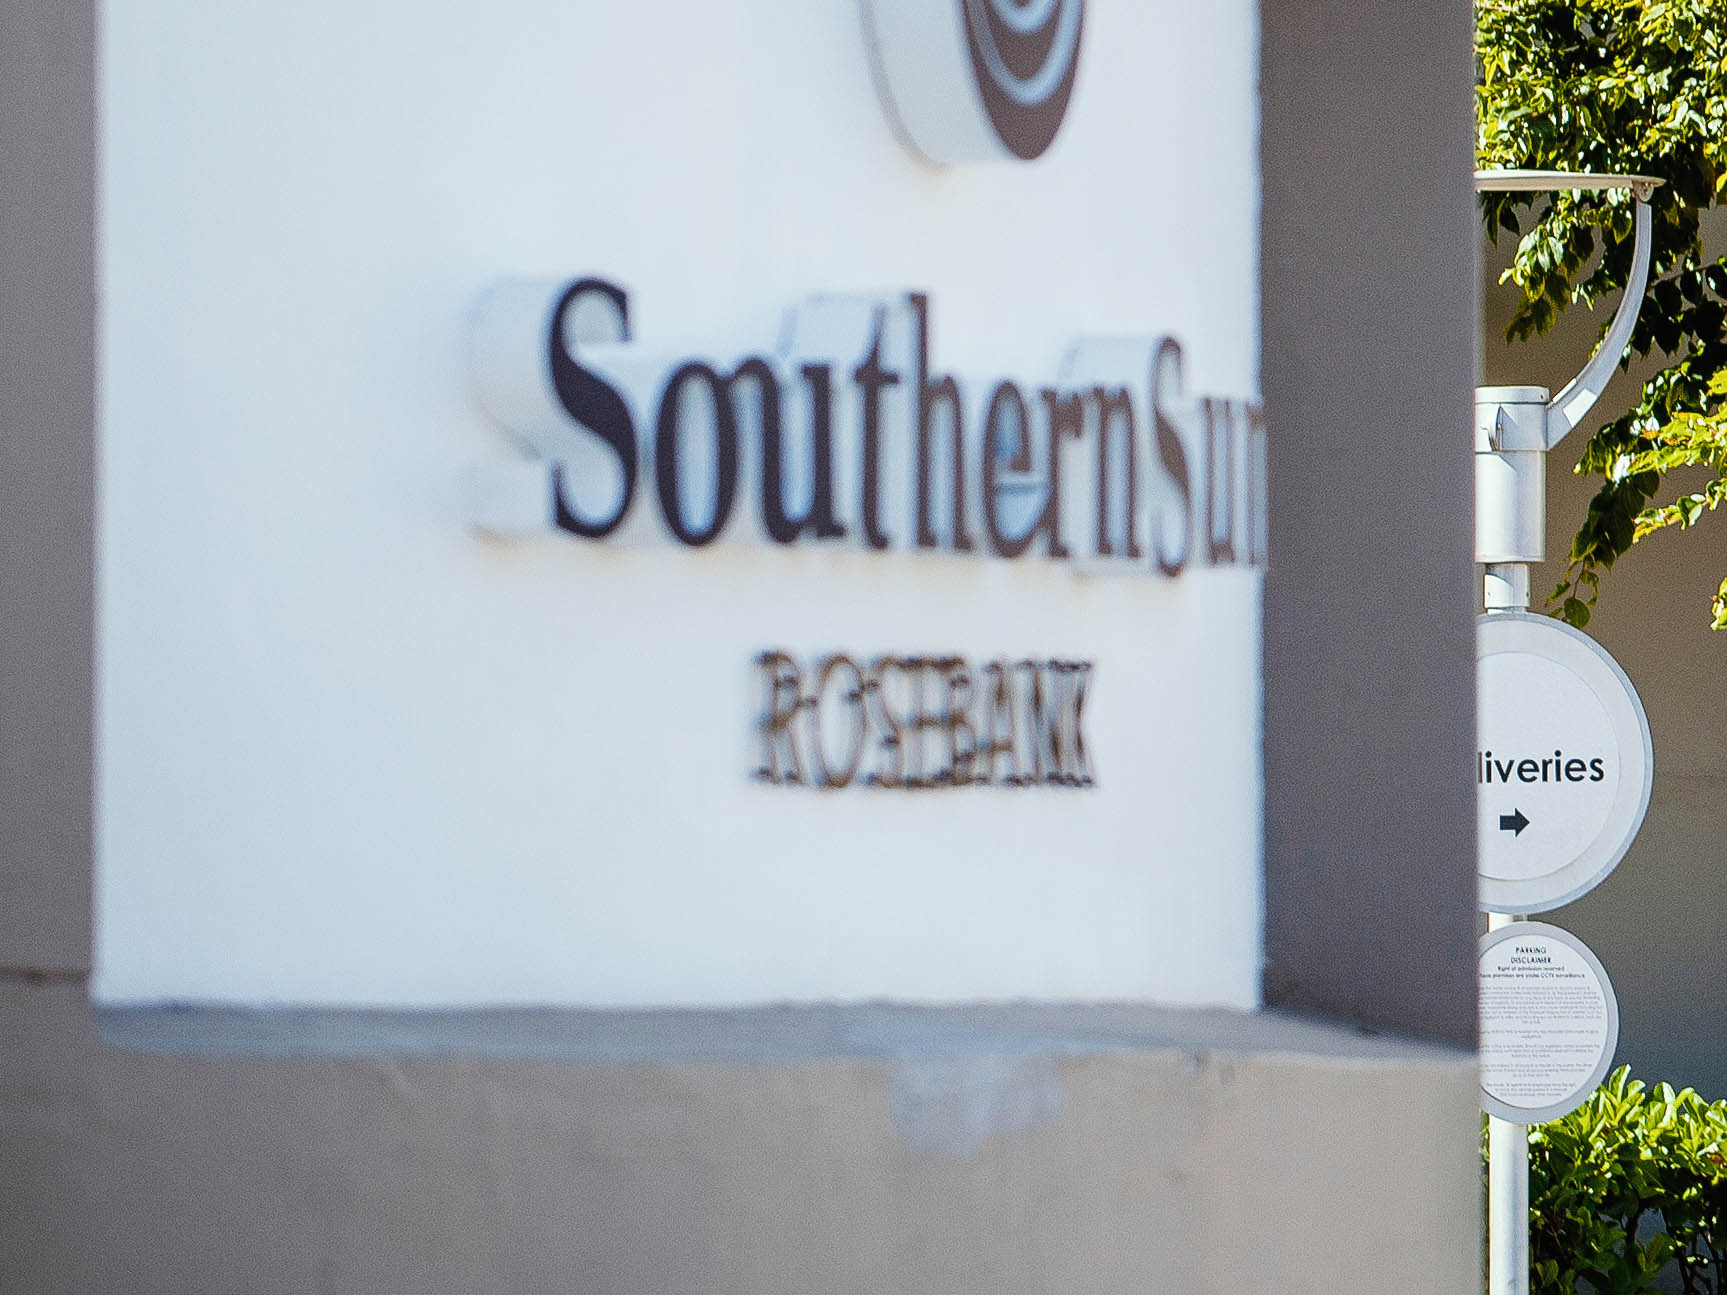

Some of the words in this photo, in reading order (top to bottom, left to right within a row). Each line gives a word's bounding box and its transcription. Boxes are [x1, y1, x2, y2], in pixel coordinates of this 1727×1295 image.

[546, 276, 1142, 561] Southern
[748, 649, 1099, 790] ROSEBANK
[1510, 956, 1552, 964] DISCLAIMER
[1515, 946, 1547, 954] PARKING
